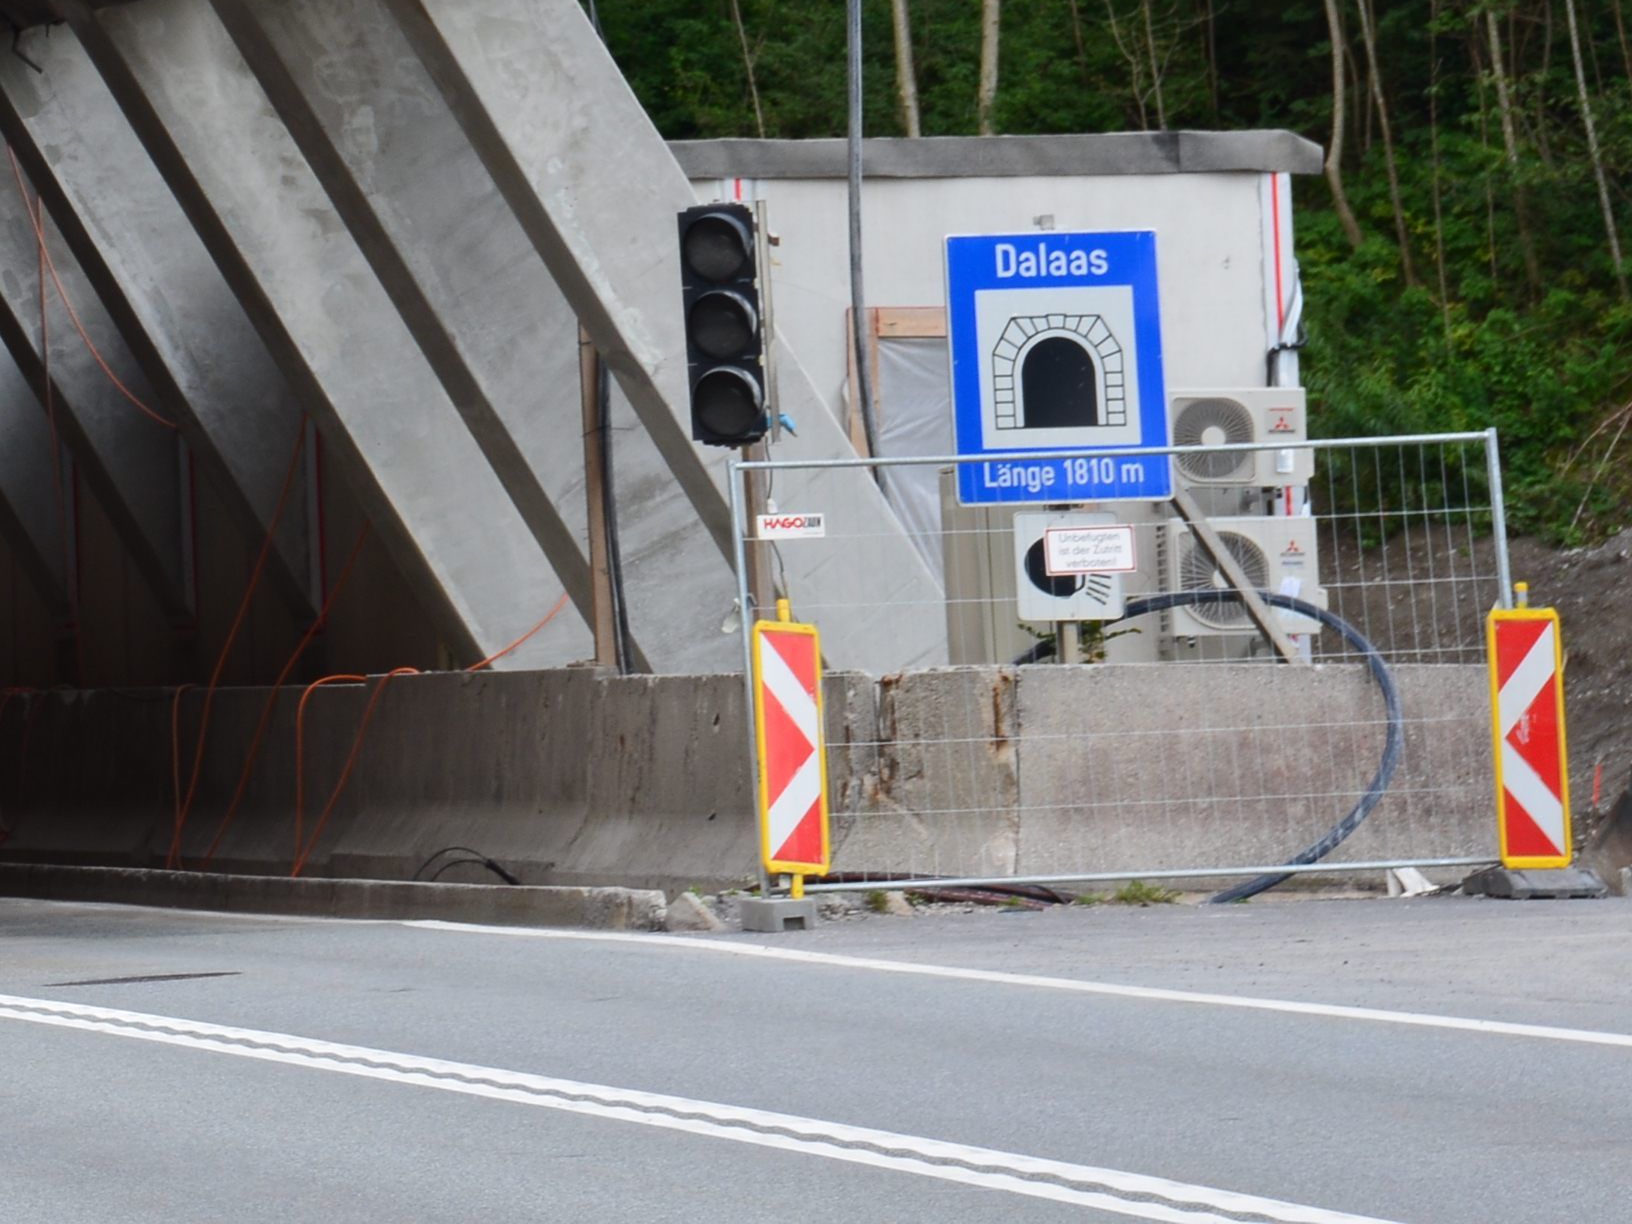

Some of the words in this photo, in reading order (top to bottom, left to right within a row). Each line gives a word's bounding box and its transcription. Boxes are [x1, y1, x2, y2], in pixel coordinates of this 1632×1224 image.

[994, 242, 1109, 278] Dalaas
[983, 461, 1056, 493] Länge
[1063, 457, 1115, 485] 1810
[1121, 462, 1145, 484] m
[764, 517, 804, 529] HAGO
